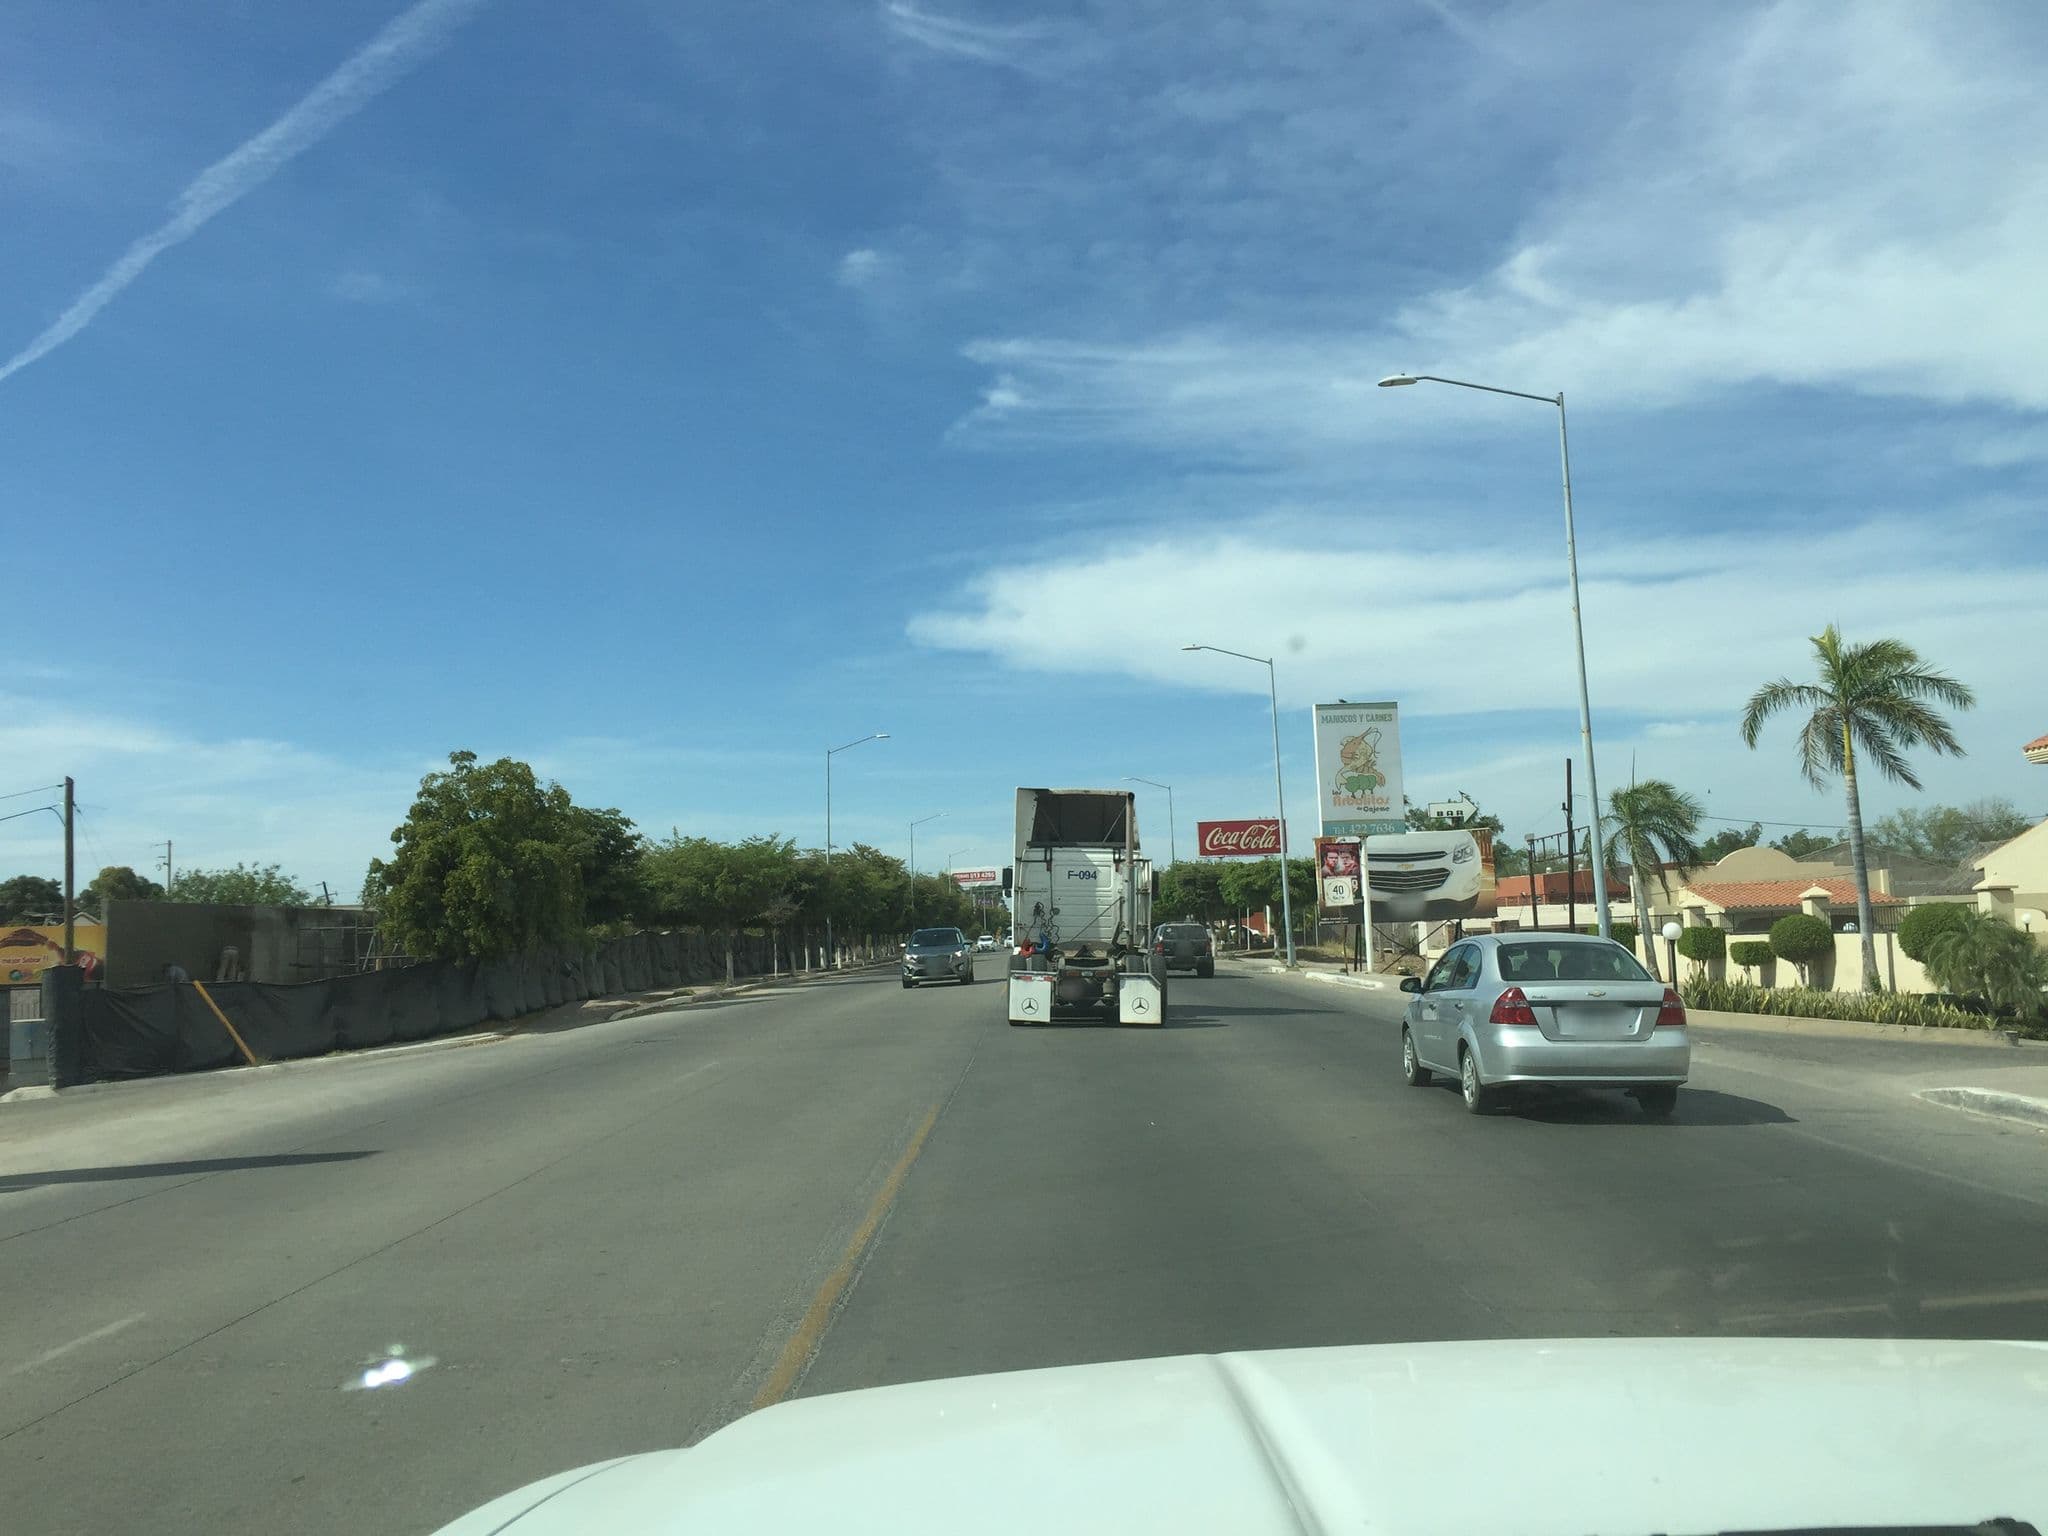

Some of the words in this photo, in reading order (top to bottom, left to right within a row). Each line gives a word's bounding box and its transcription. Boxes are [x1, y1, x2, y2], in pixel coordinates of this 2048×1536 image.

[1359, 714, 1364, 722] Y
[1366, 713, 1393, 722] CARNES
[1370, 822, 1395, 834] 7636
[1067, 870, 1097, 880] F-094
[1333, 885, 1344, 895] 40
